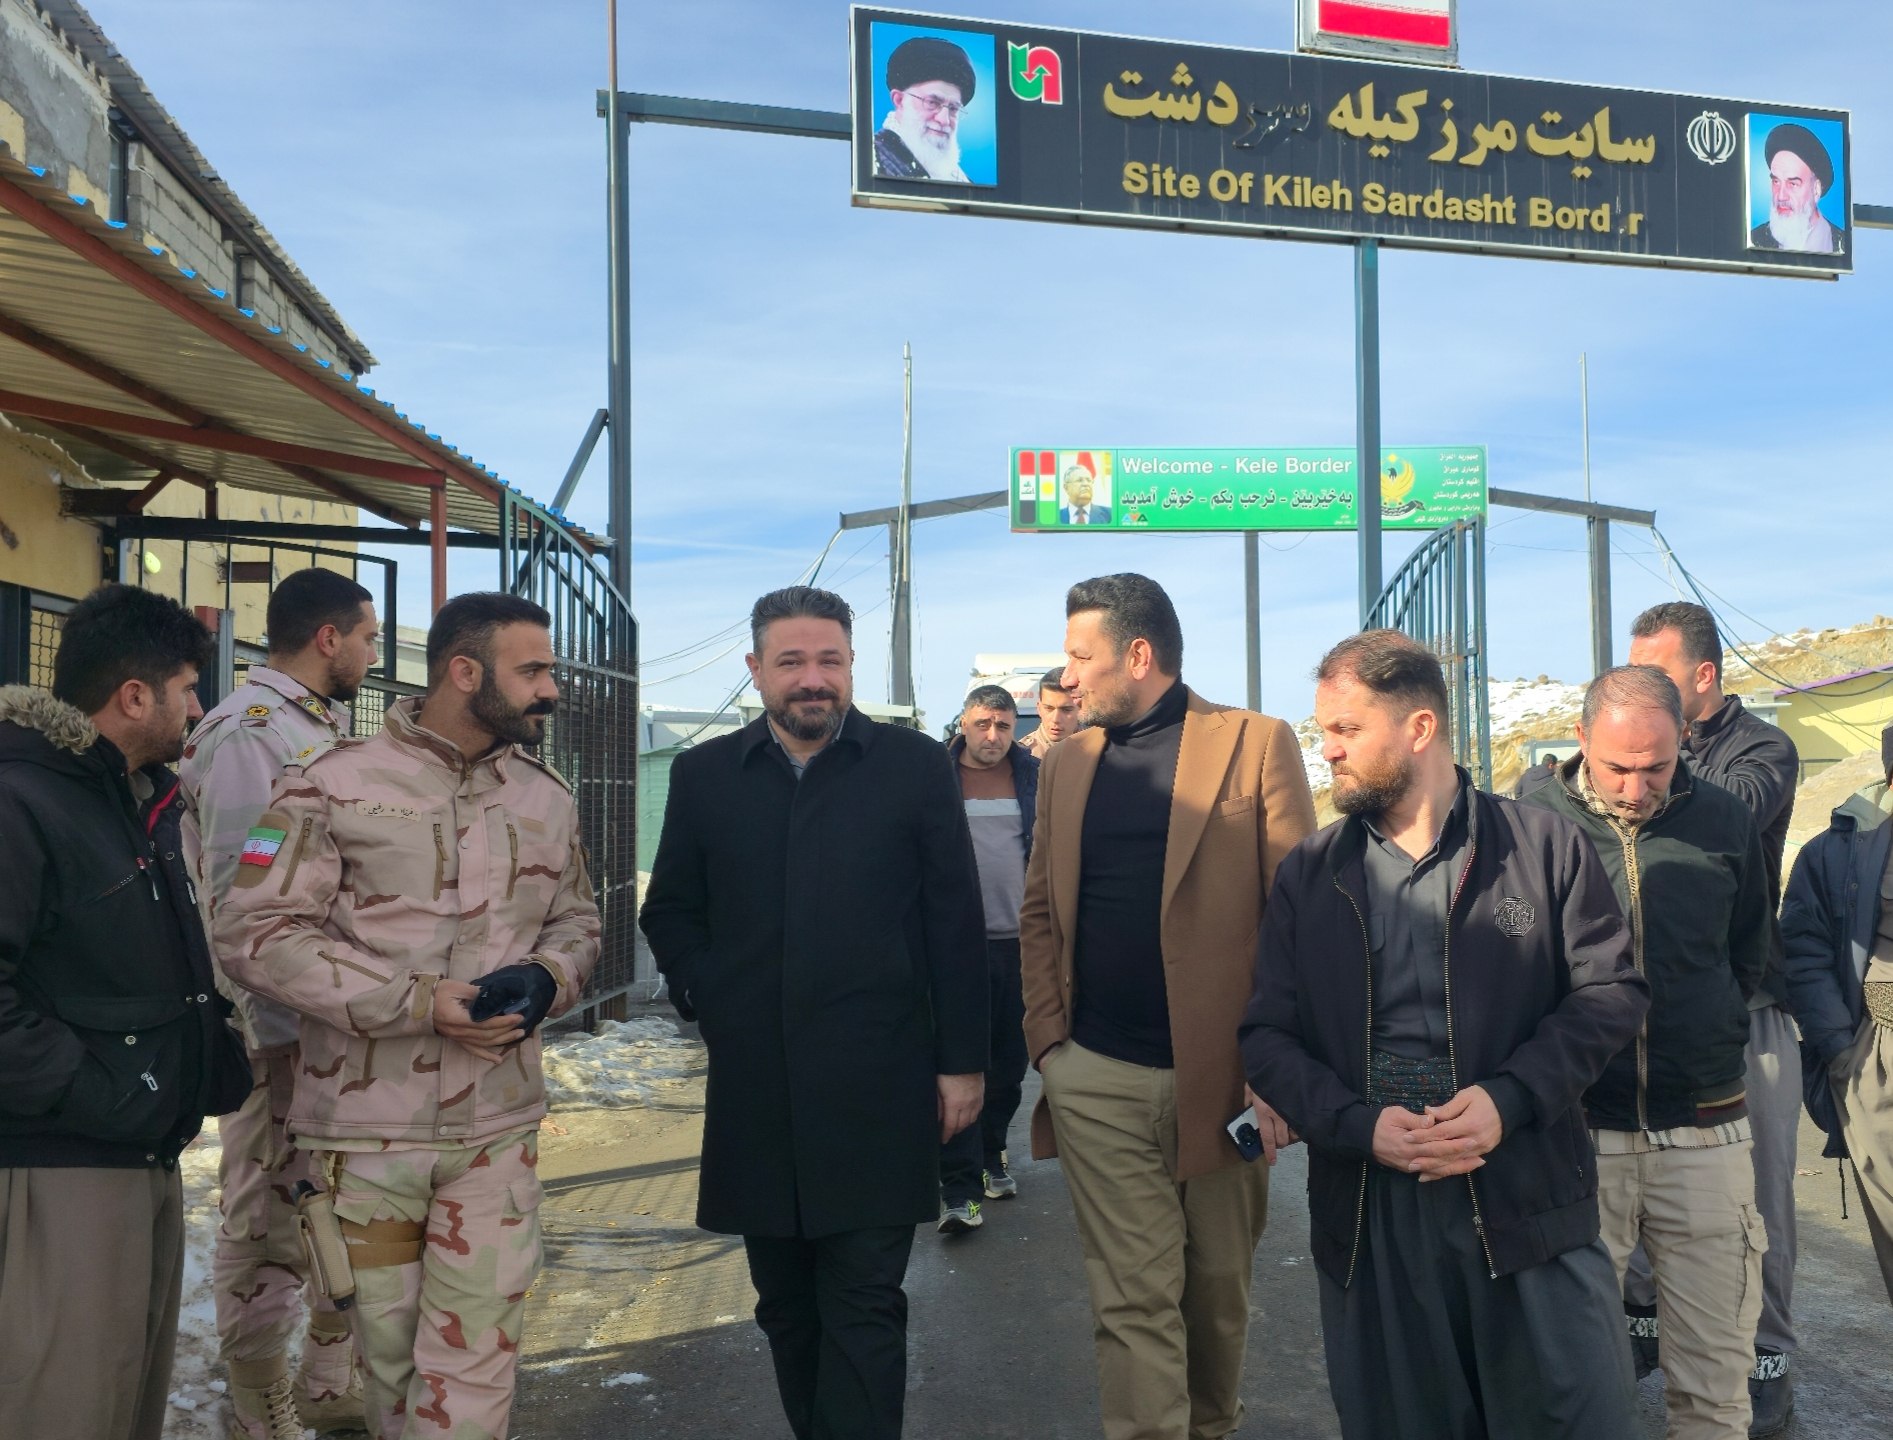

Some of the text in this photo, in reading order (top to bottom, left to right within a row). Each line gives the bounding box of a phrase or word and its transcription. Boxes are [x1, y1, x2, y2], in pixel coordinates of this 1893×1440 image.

[1328, 82, 1428, 158] کیله
[1428, 98, 1518, 166] مرز
[1526, 106, 1656, 178] سایت
[1122, 161, 1643, 235] Site Of Kileh Sardasht Bordr
[1121, 457, 1214, 474] Welcome
[1235, 457, 1278, 474] Kele
[1285, 457, 1352, 474] Border
[1162, 487, 1195, 509] خوش
